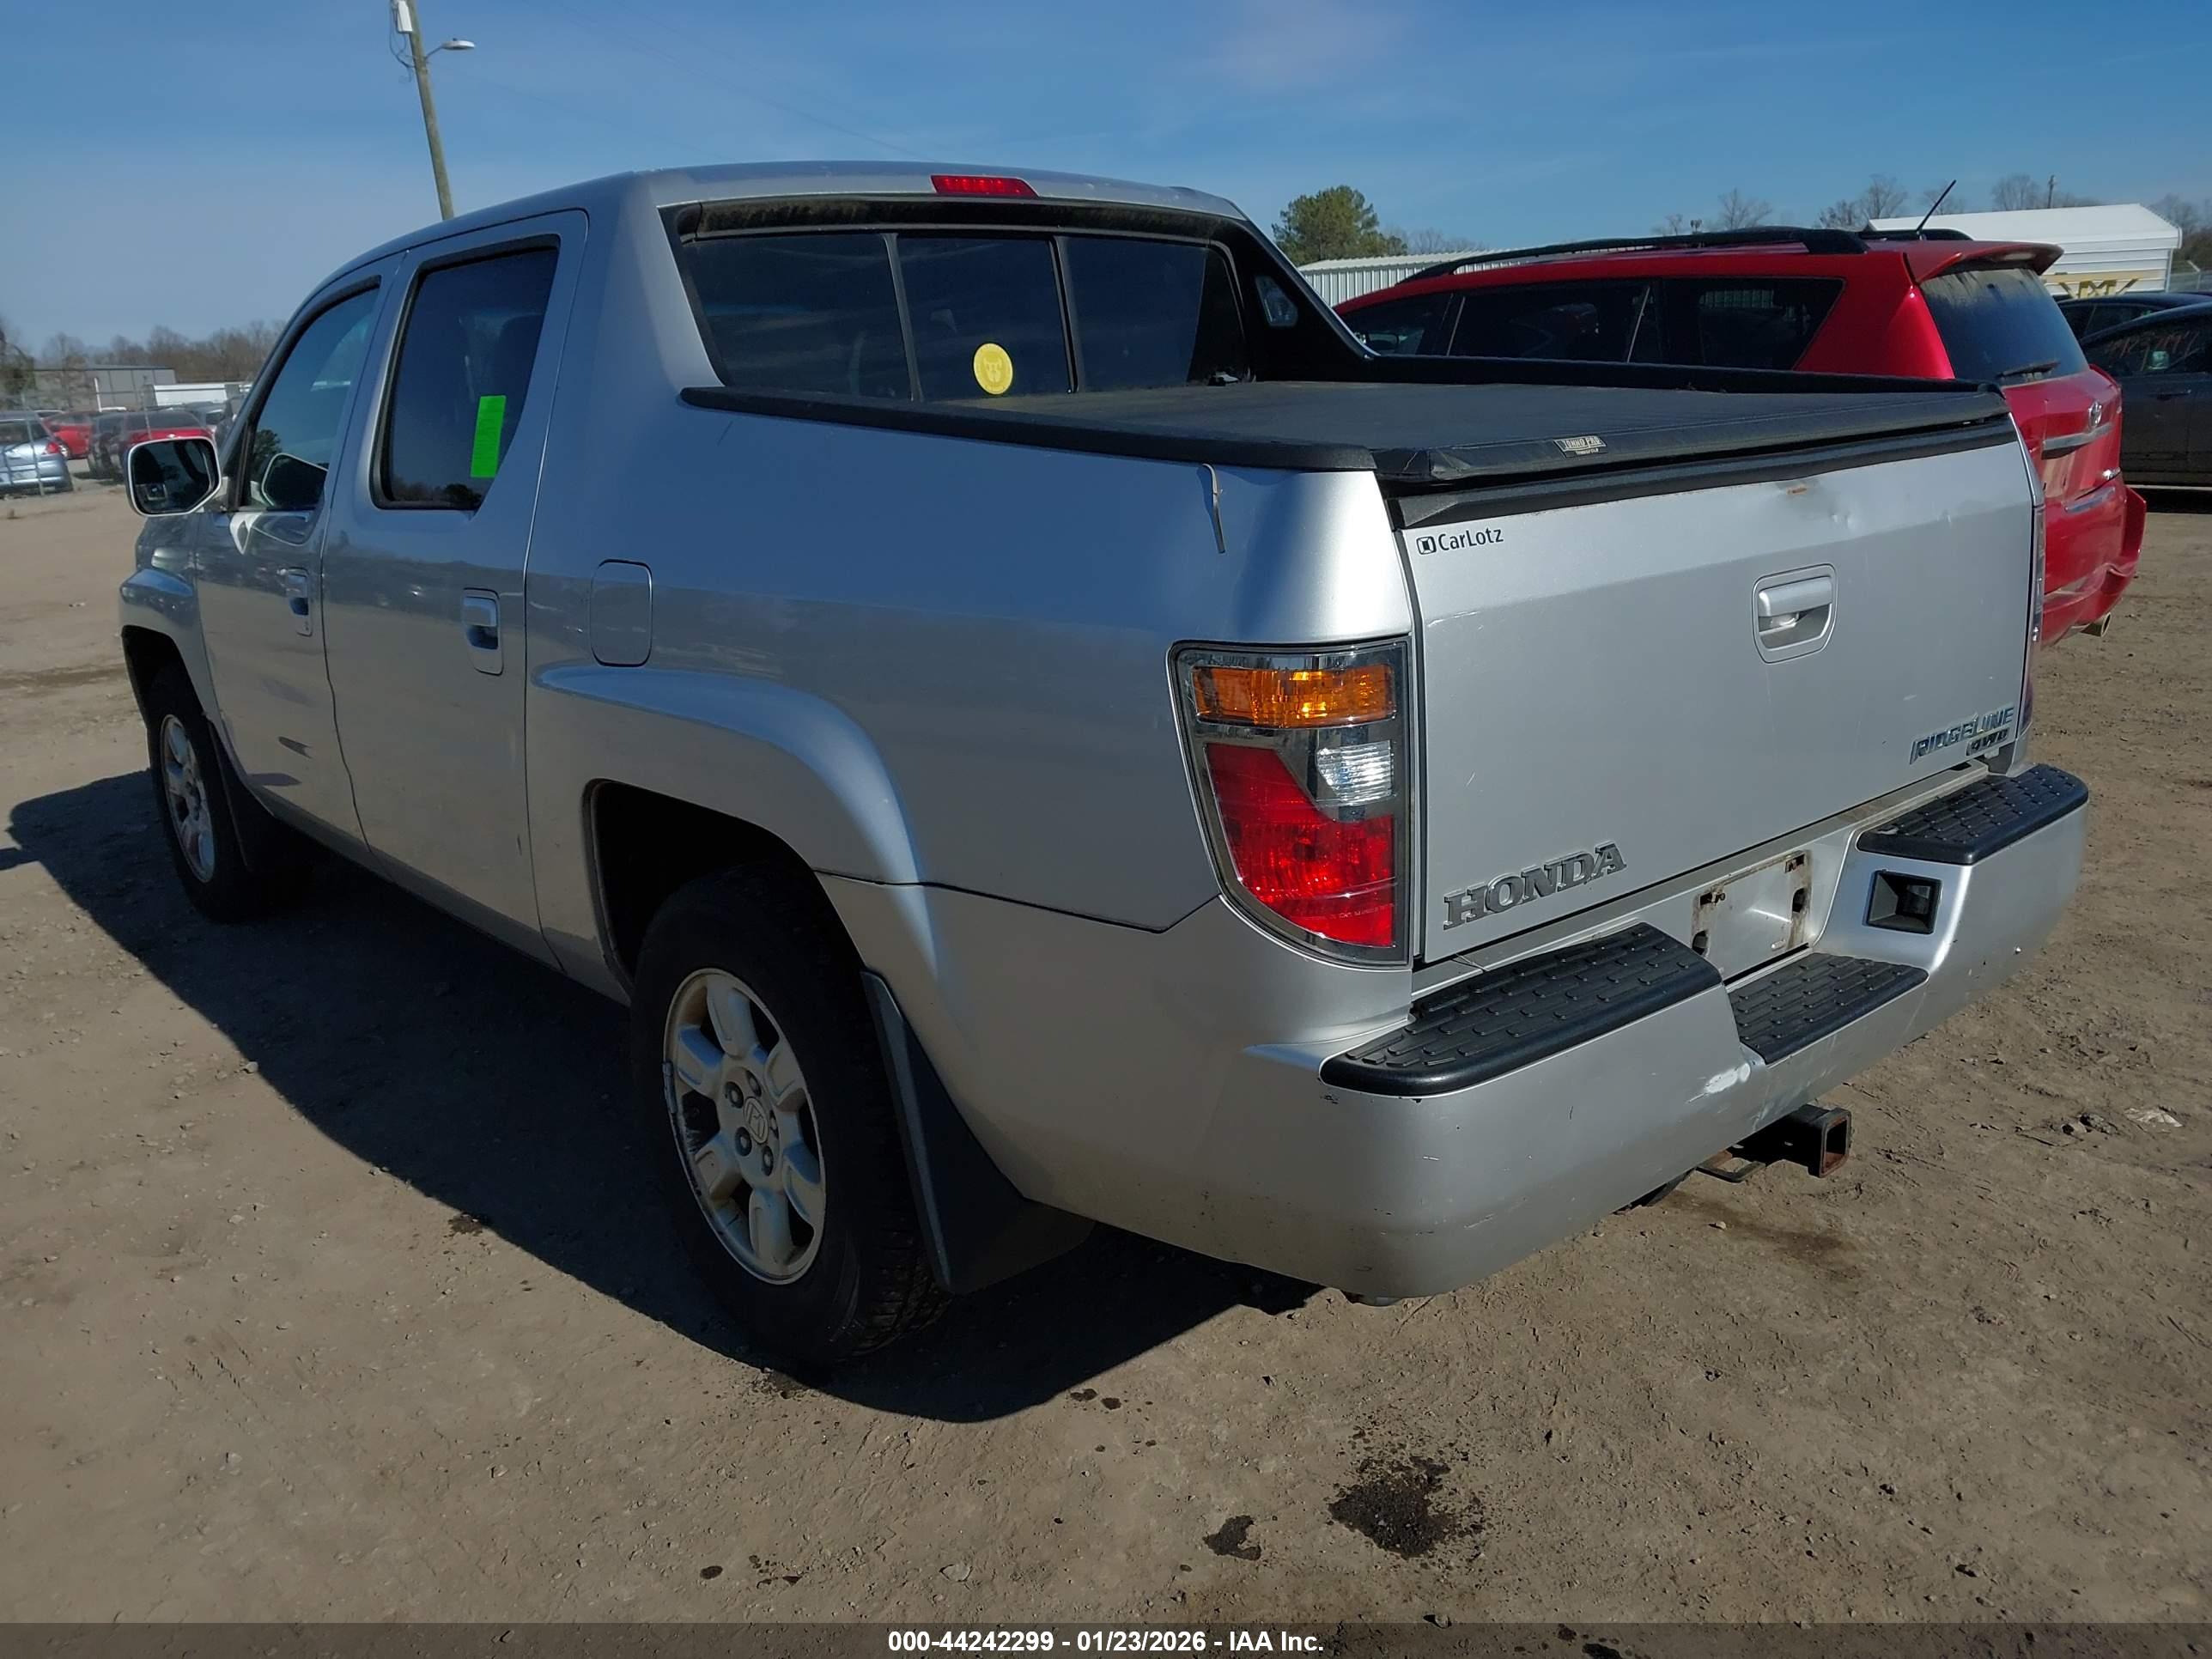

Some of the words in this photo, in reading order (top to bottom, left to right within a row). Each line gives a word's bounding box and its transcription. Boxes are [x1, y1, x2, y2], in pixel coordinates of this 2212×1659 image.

[1438, 527, 1504, 551] CarLotz
[1909, 707, 2014, 764] RIDGELINE
[1443, 840, 1627, 931] HONDA
